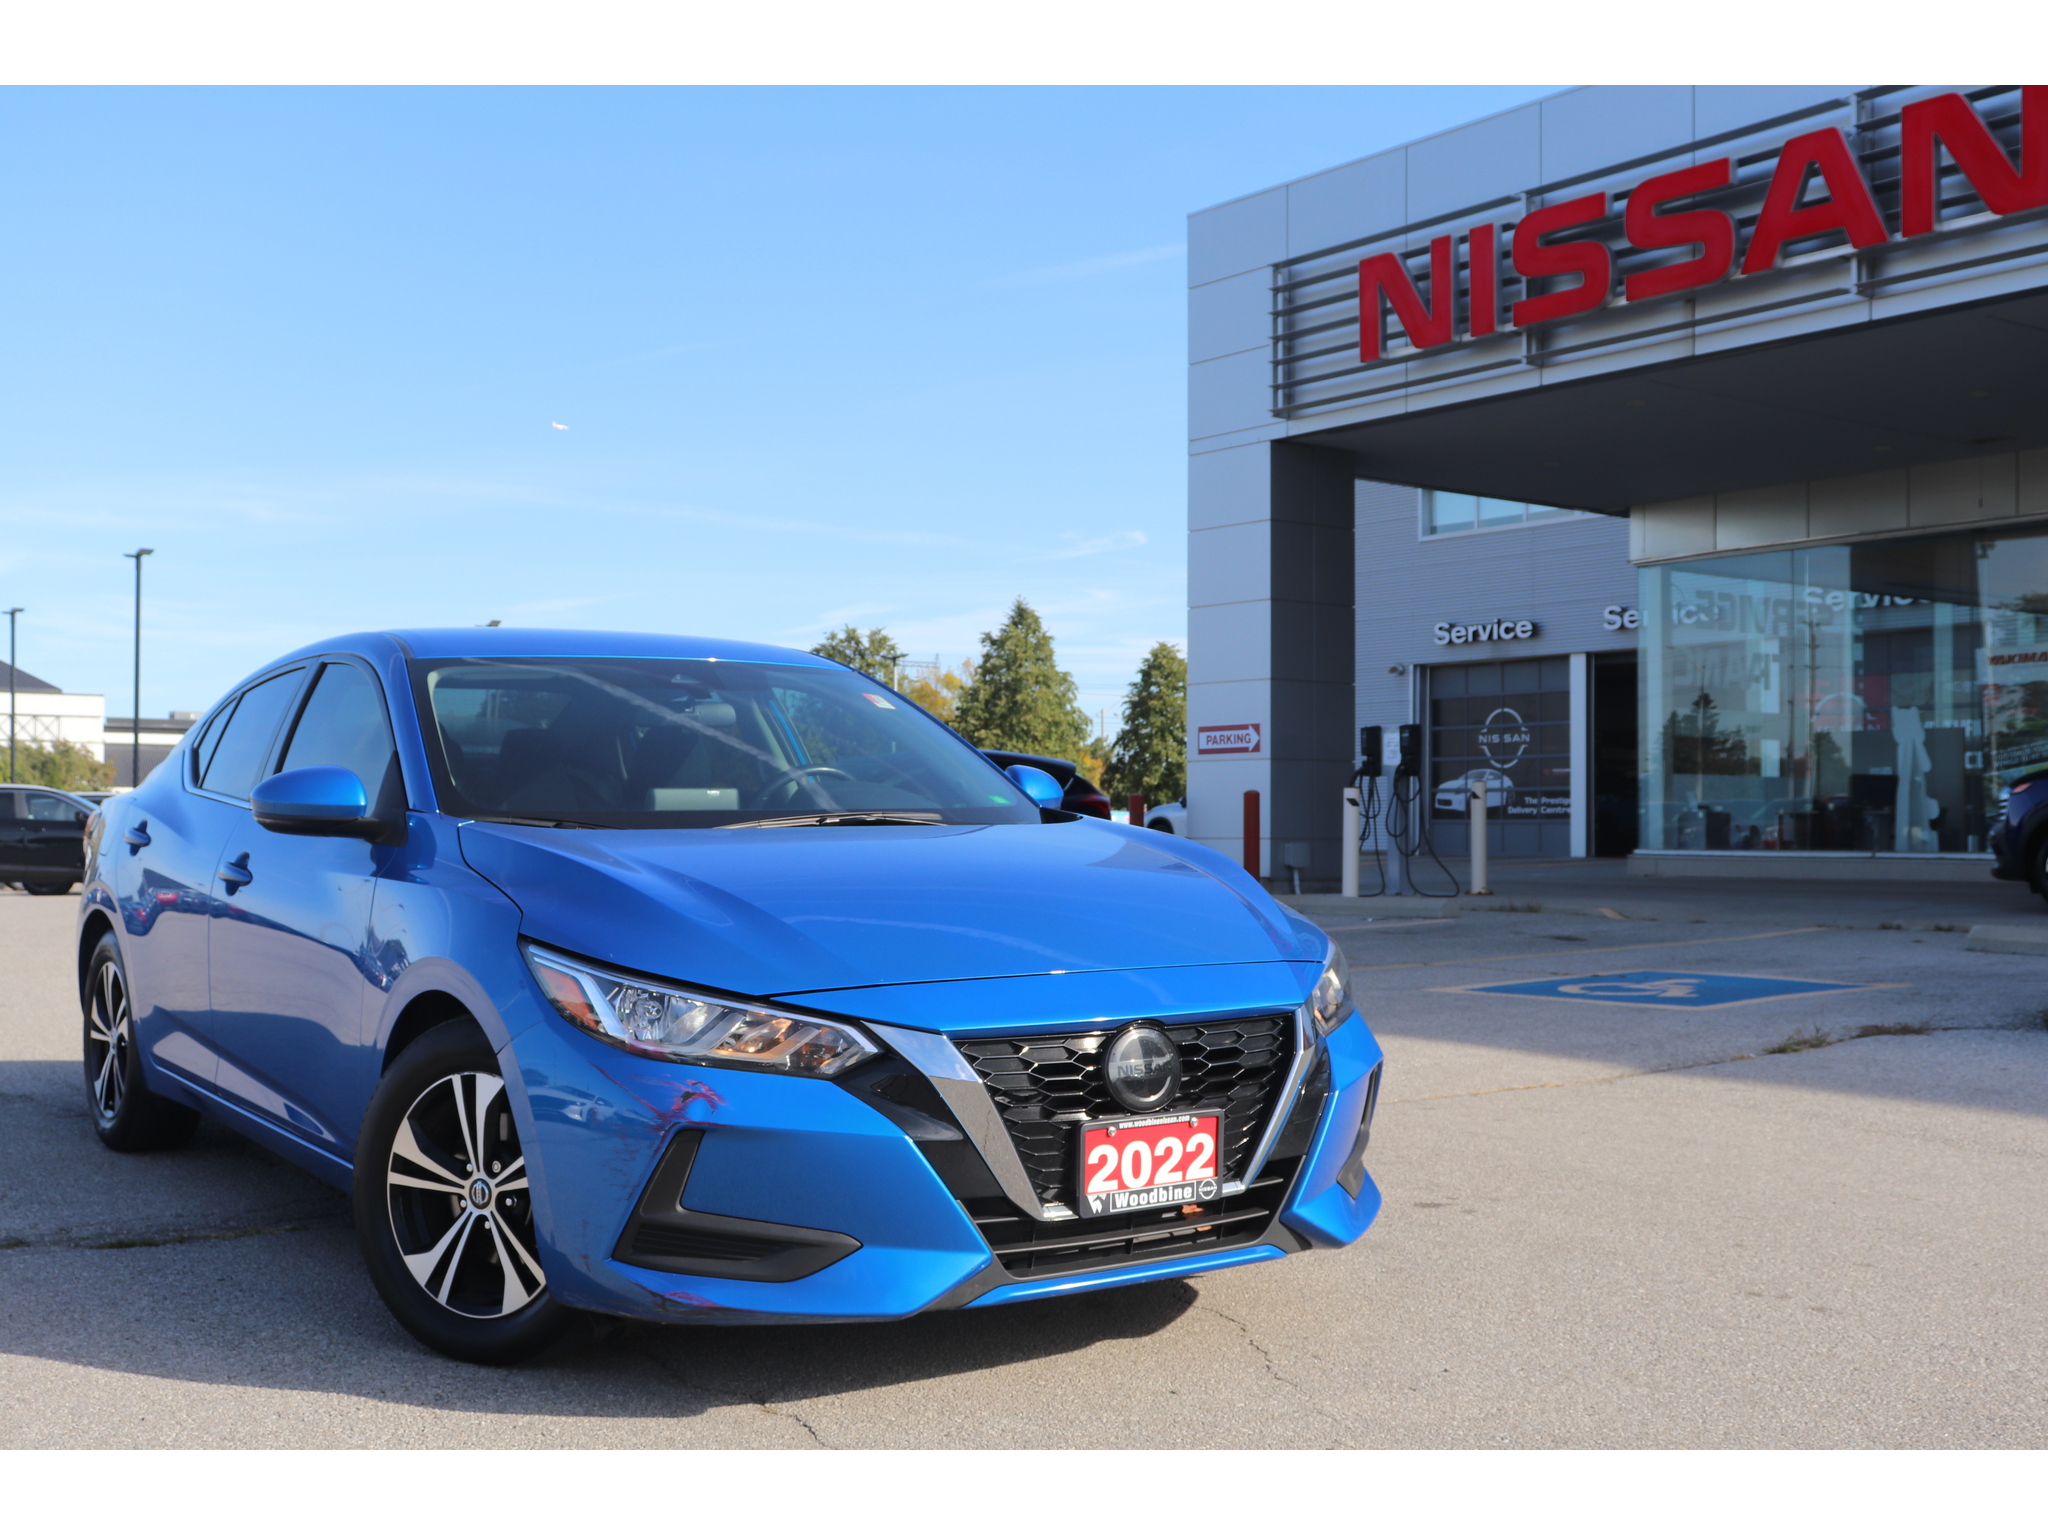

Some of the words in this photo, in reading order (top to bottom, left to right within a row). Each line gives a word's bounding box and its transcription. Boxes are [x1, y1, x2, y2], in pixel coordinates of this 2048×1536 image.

[1359, 85, 2048, 362] NISSAN
[1434, 618, 1533, 645] Service
[1206, 733, 1251, 745] PARKING
[1478, 733, 1530, 744] NISSAN
[1508, 806, 1538, 815] Delivery
[1087, 1132, 1214, 1193] 2022
[1114, 1186, 1193, 1208] Woodbine
